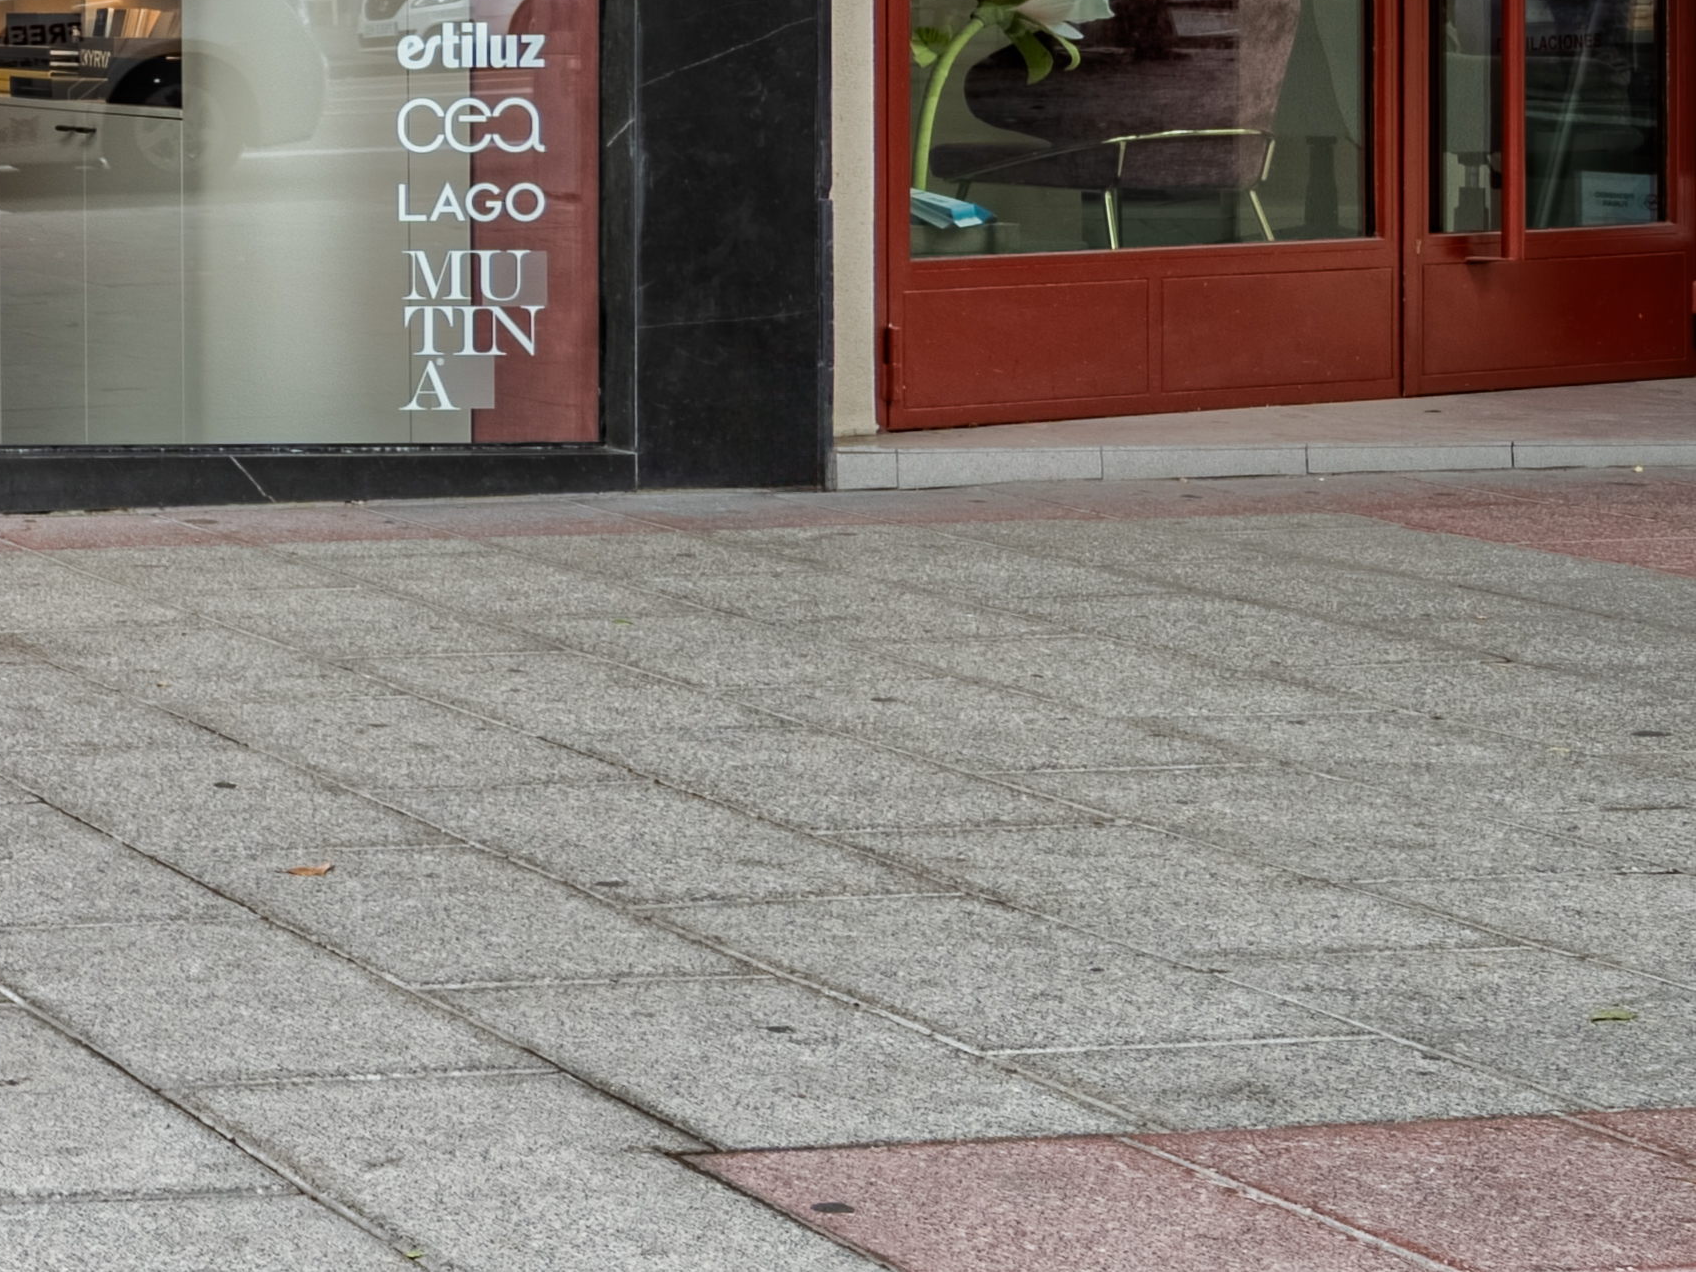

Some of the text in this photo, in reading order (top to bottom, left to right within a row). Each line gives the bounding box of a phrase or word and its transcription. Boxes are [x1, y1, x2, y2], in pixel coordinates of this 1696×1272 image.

[396, 22, 546, 70] estiluz
[396, 96, 546, 154] cea
[398, 182, 546, 222] LAGO
